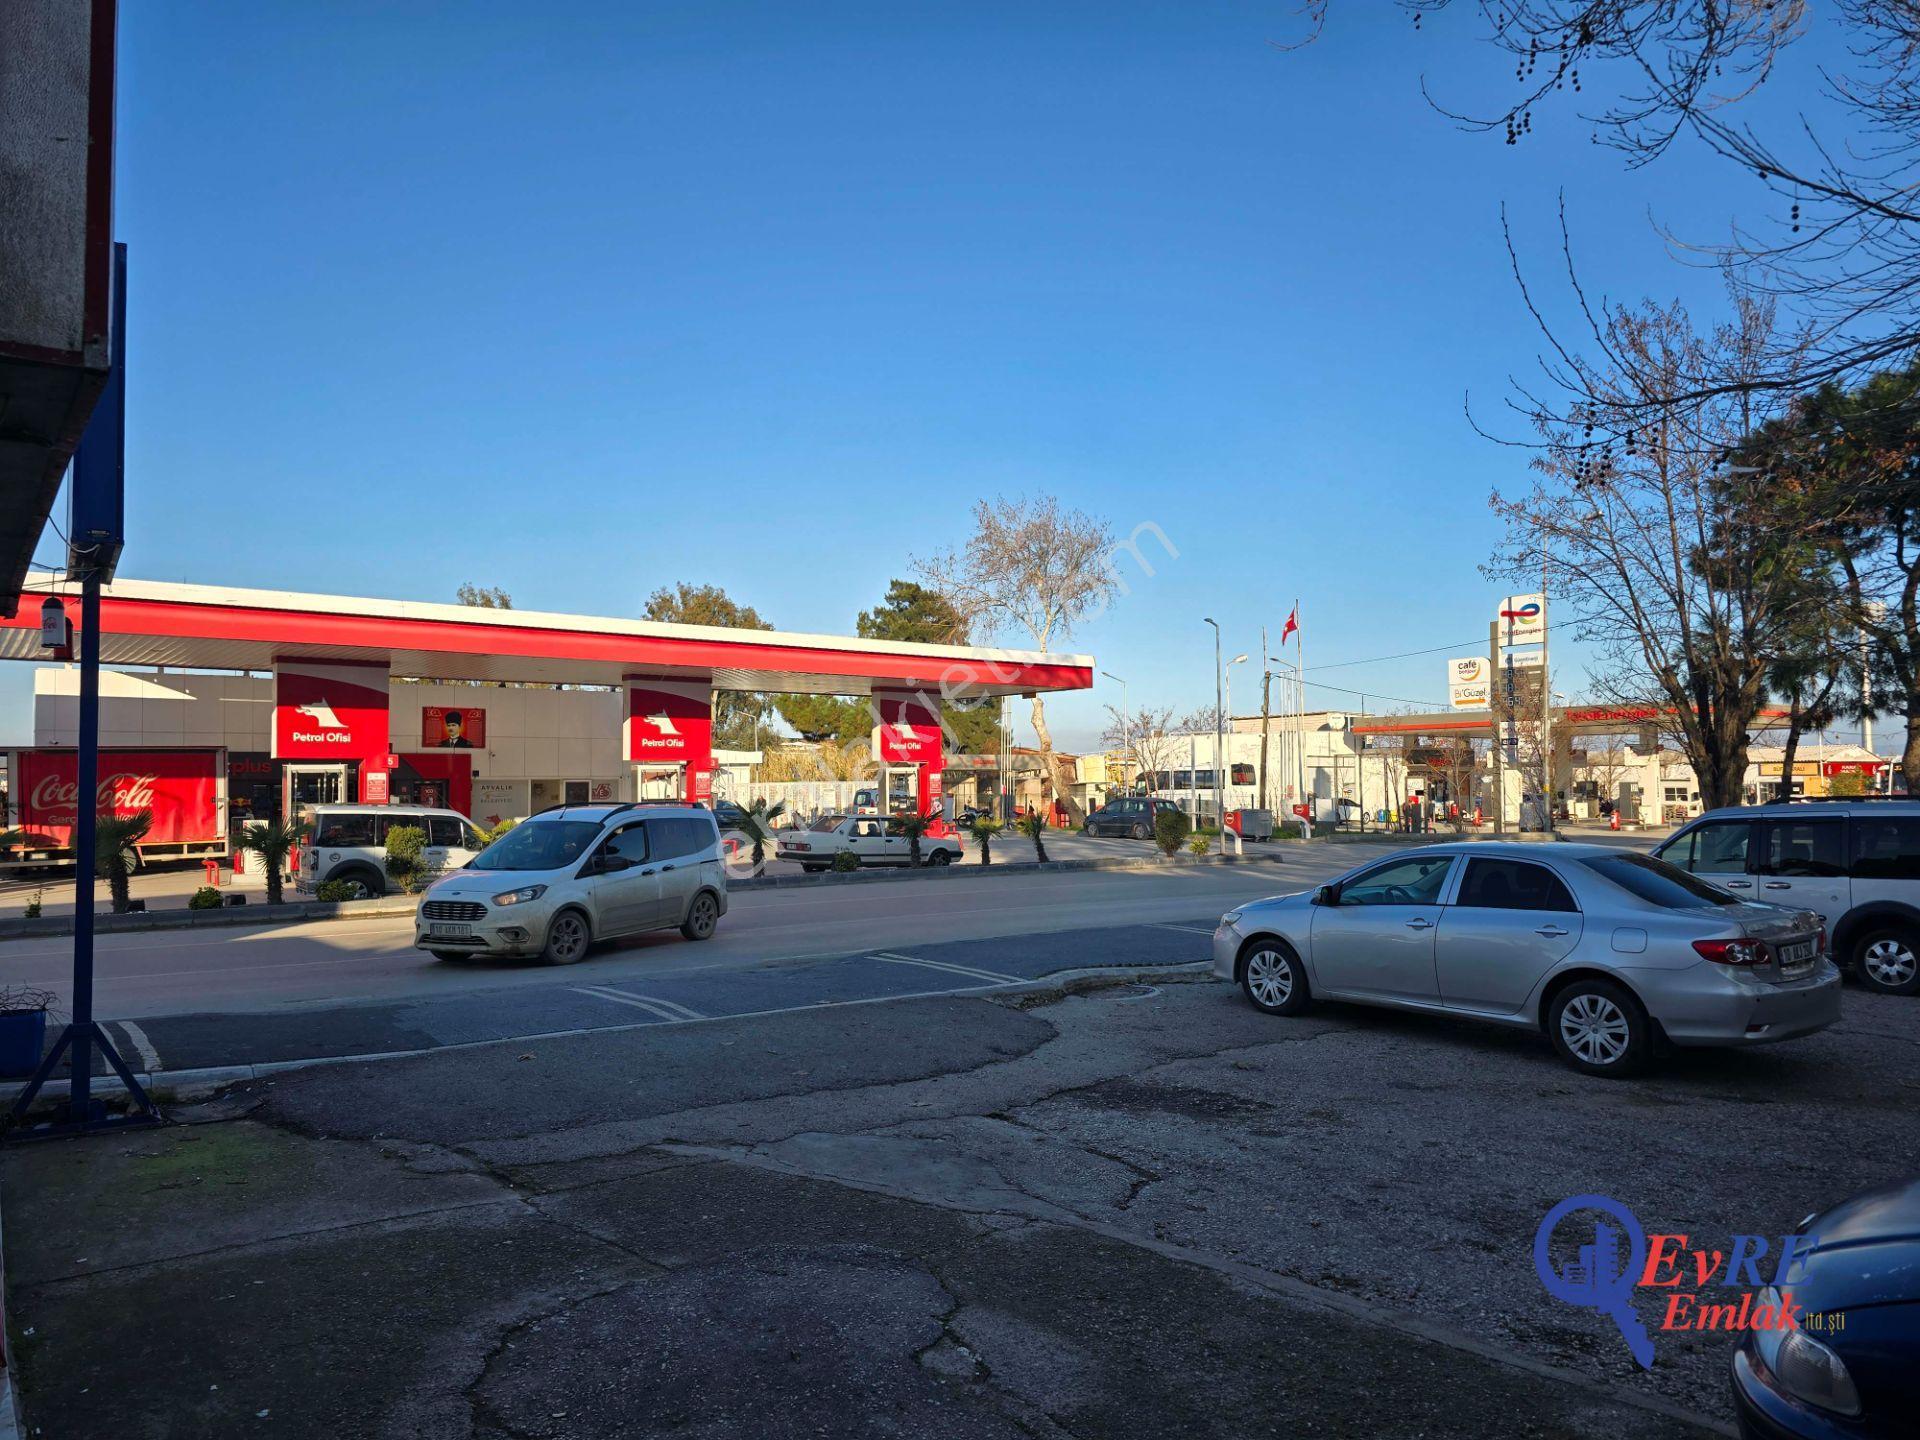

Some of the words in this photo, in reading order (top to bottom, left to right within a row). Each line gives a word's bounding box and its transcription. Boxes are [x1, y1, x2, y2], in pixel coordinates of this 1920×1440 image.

[292, 732, 324, 742] Petrol
[326, 732, 351, 743] Ofisi
[641, 738, 665, 747] Petrol
[666, 739, 684, 747] Ofisi
[889, 742, 906, 750] Petrol
[907, 742, 921, 750] Ofisi
[231, 757, 272, 776] plus
